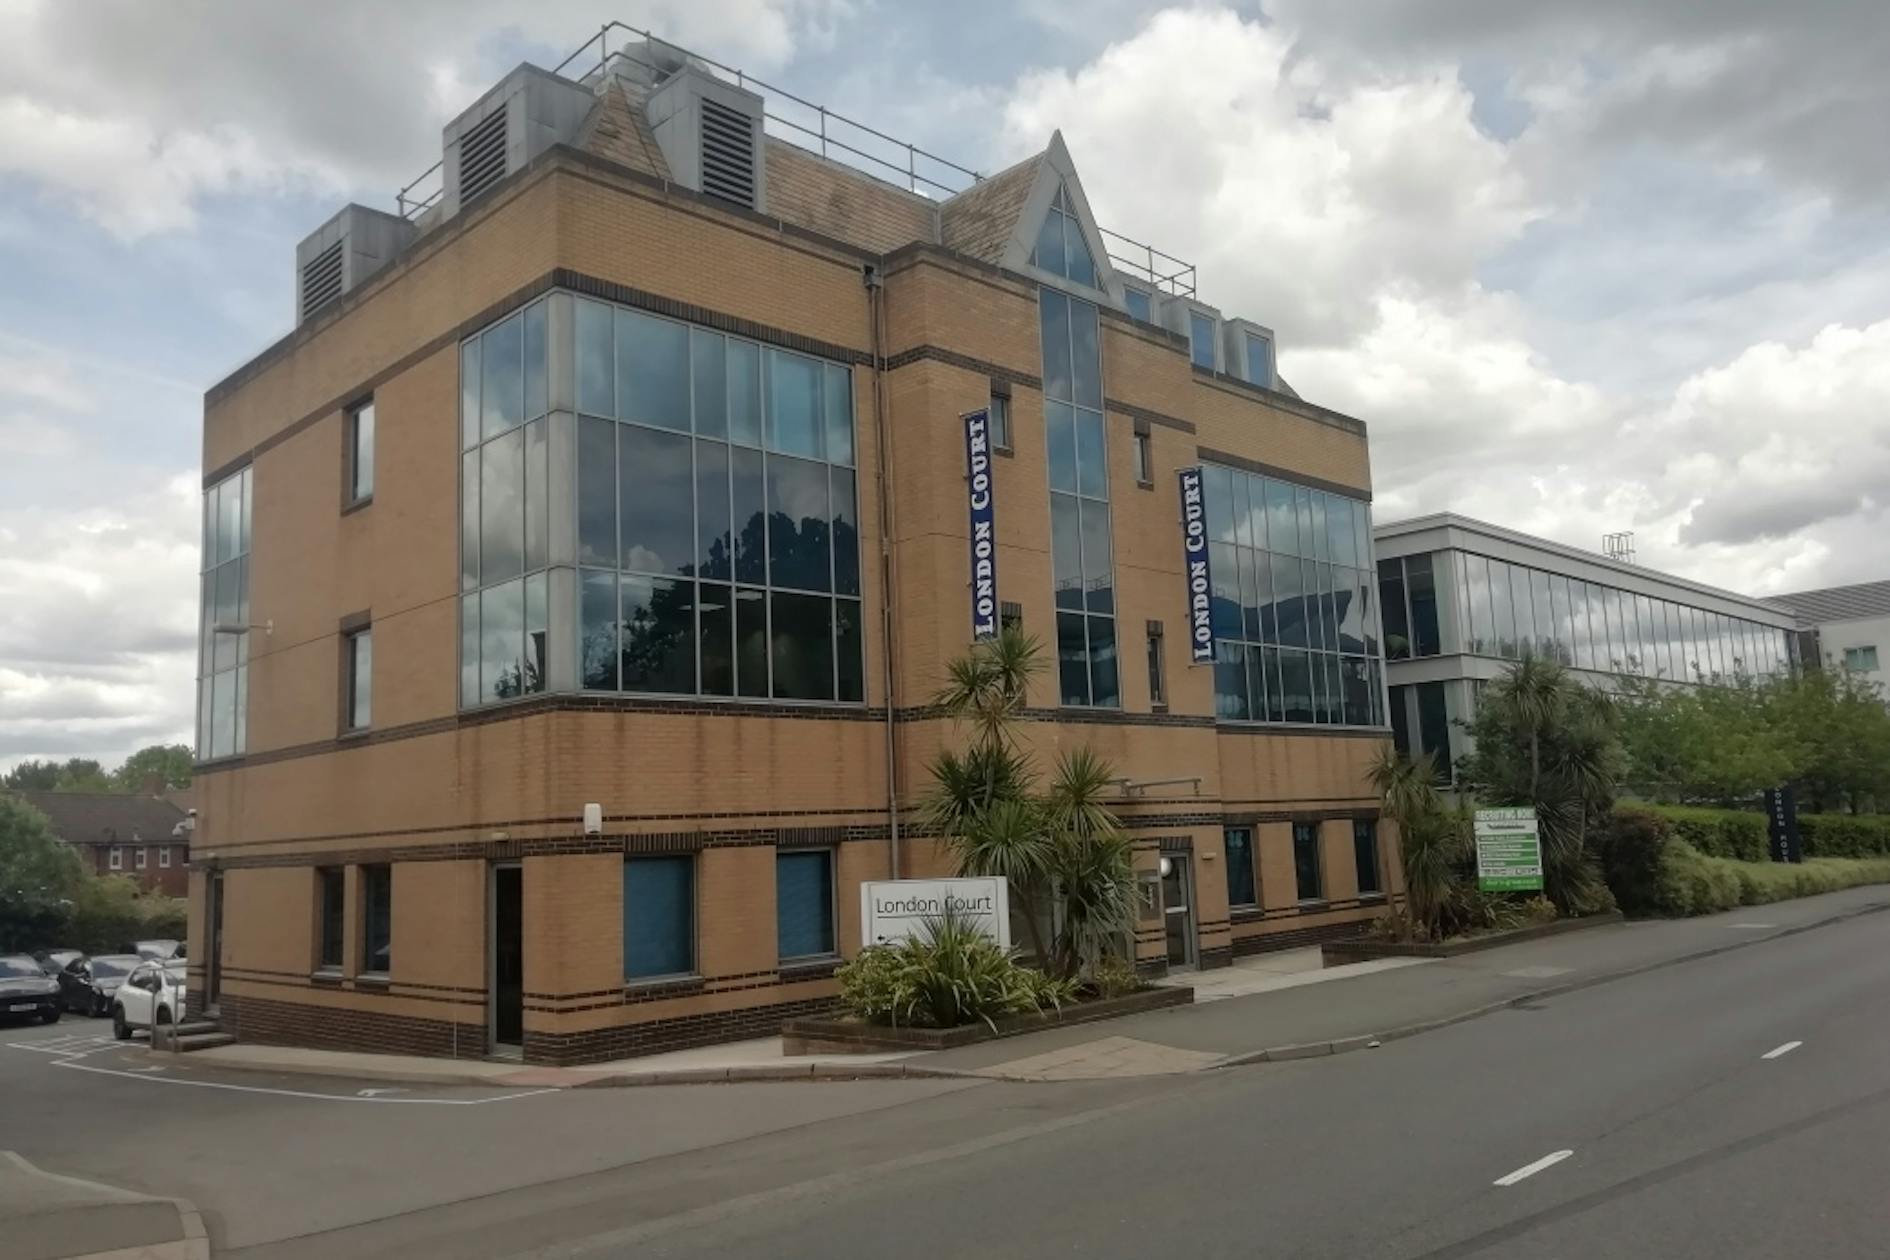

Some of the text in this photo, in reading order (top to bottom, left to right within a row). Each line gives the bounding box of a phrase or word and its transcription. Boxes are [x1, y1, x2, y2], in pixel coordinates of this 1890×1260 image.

[969, 420, 994, 634] LONDON COURT
[1183, 475, 1212, 659] LONDON COURT
[876, 895, 992, 914] London Court
